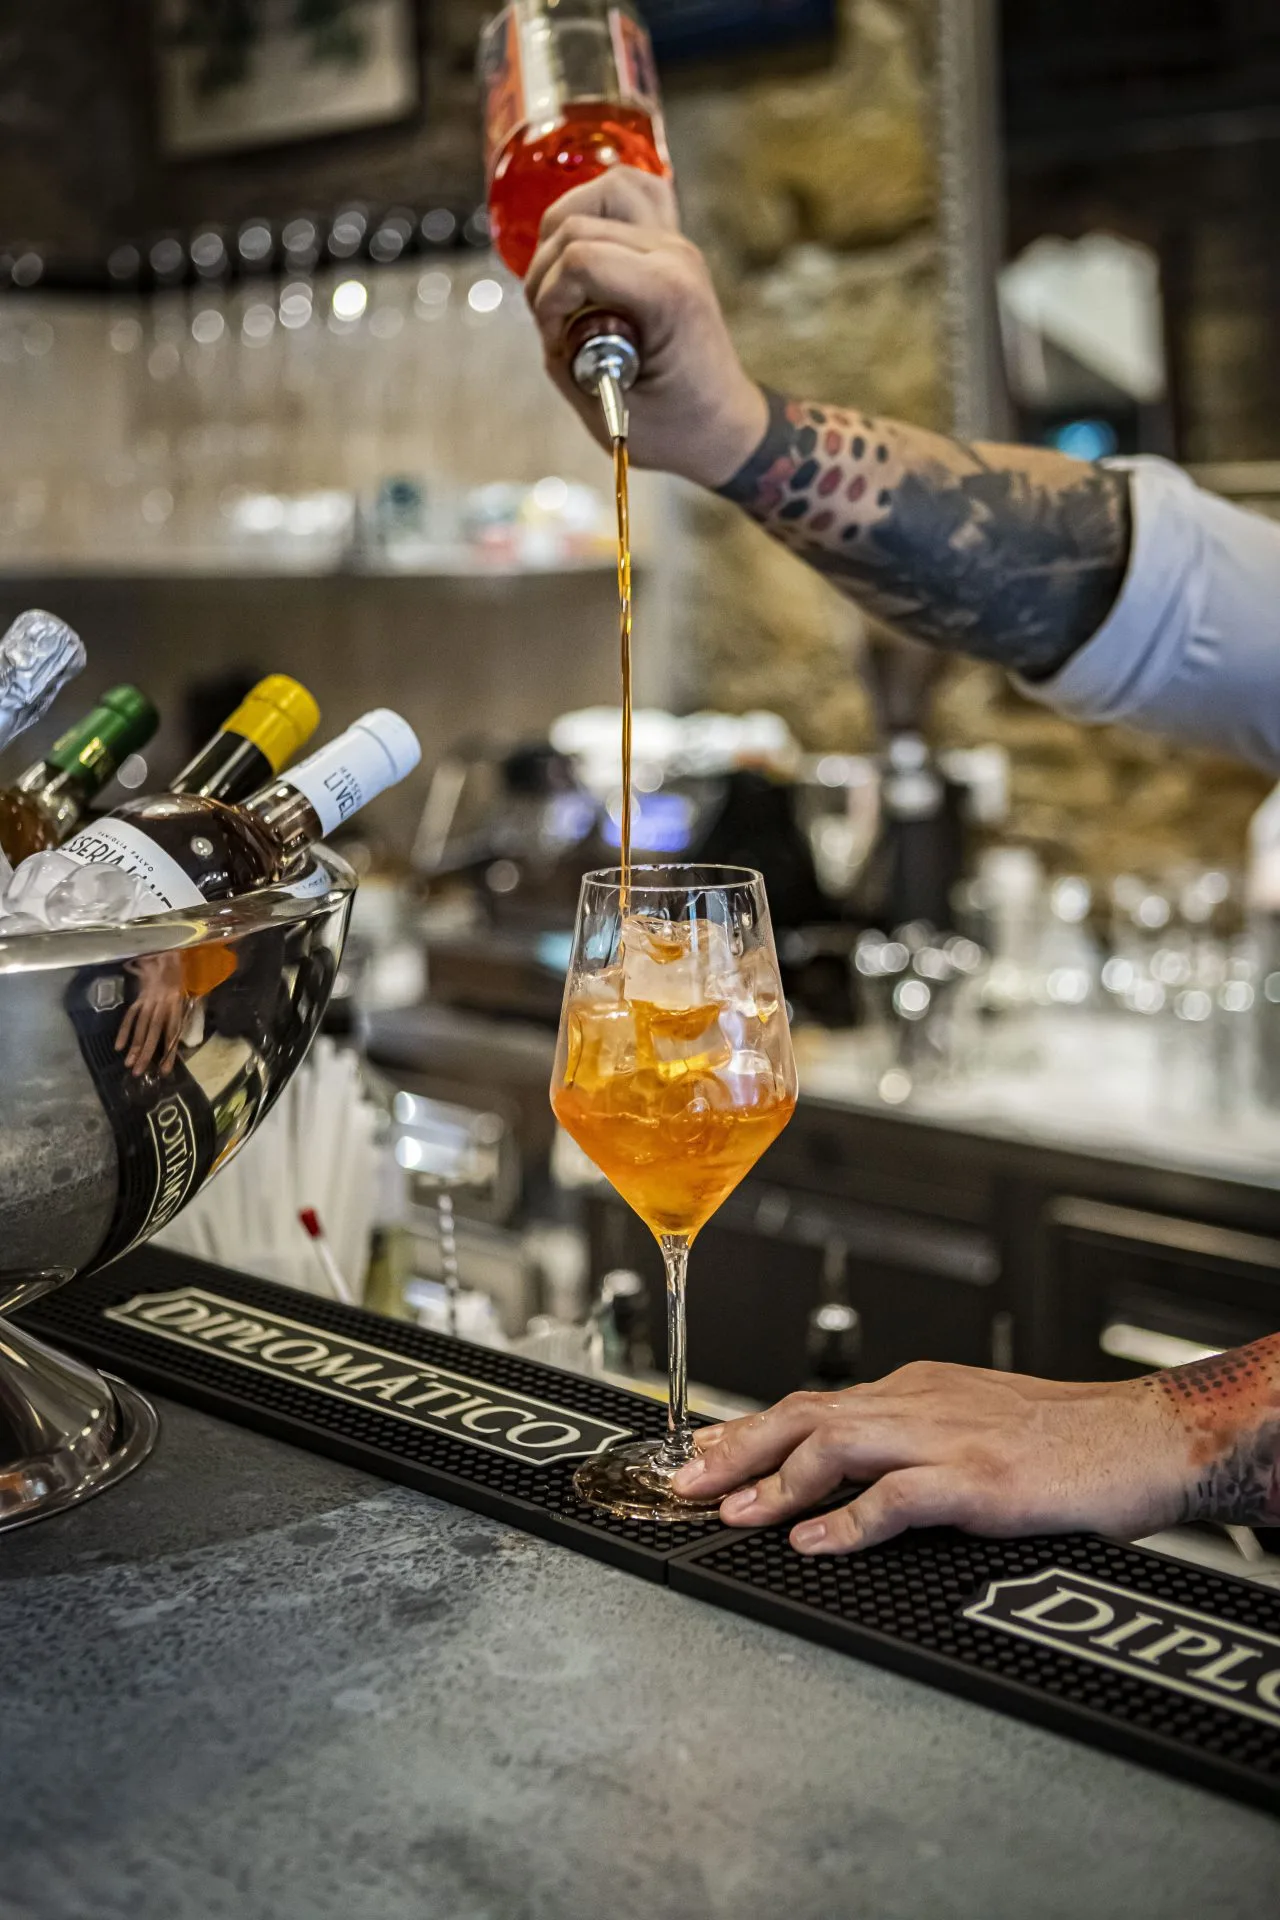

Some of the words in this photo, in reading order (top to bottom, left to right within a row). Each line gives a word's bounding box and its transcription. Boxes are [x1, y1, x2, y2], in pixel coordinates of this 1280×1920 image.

[130, 850, 154, 872] FALVO
[138, 1299, 581, 1448] DIPLOMÁTICO
[1010, 1585, 1280, 1709] DIPL
